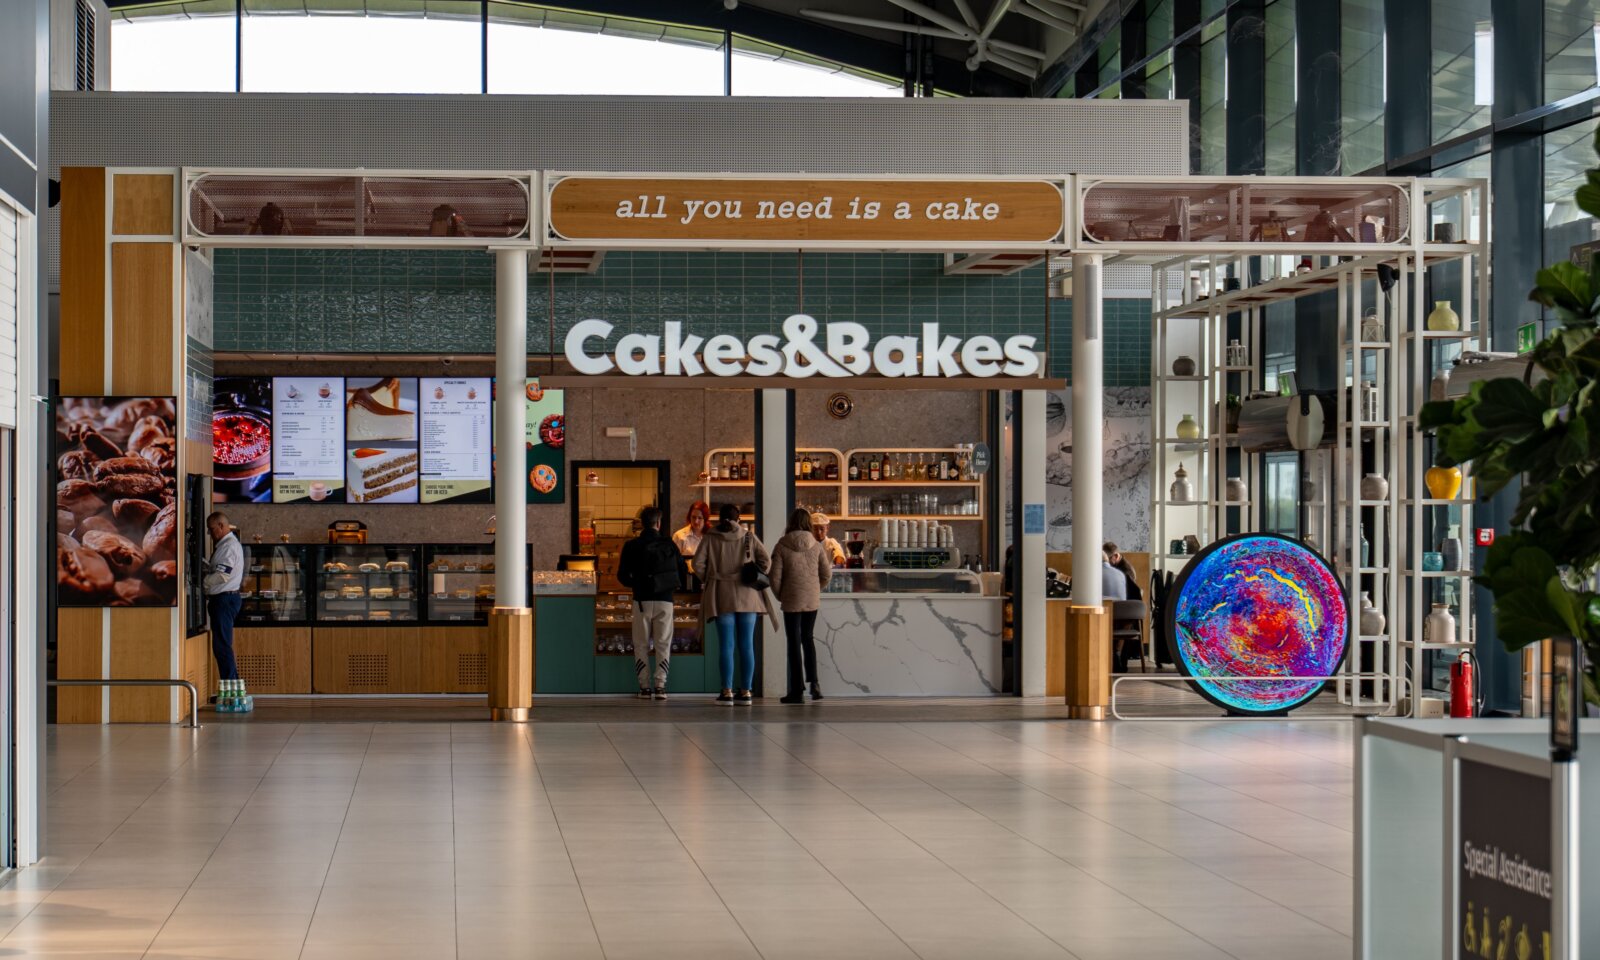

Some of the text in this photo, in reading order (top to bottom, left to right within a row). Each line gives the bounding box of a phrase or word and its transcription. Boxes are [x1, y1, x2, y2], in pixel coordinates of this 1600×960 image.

[615, 195, 1000, 225] all you need is a cake
[563, 313, 1040, 379] Cakes&Bakes
[1464, 840, 1552, 898] Special Assistance
